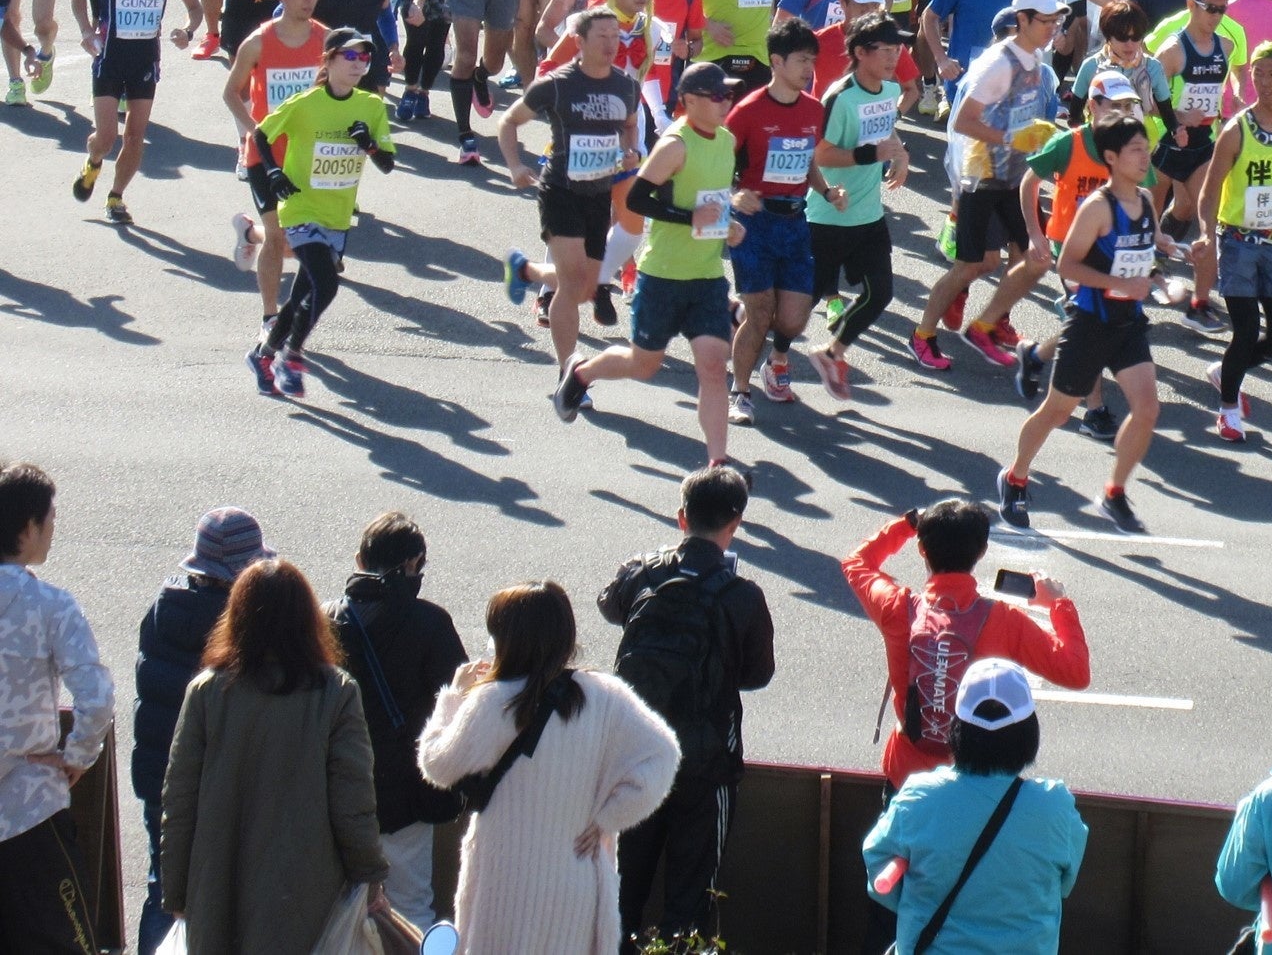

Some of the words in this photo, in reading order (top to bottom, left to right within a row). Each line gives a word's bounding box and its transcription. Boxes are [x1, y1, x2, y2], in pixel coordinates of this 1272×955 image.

[117, 10, 154, 26] 10714
[587, 93, 609, 103] THE
[572, 103, 609, 112] NORTH
[863, 101, 894, 116] GUNZE
[583, 112, 609, 121] FACE
[862, 117, 891, 136] 10593
[783, 138, 809, 150] Step
[313, 158, 354, 175] 20050
[769, 154, 806, 170] 10273
[934, 641, 951, 714] ULTIMATE
